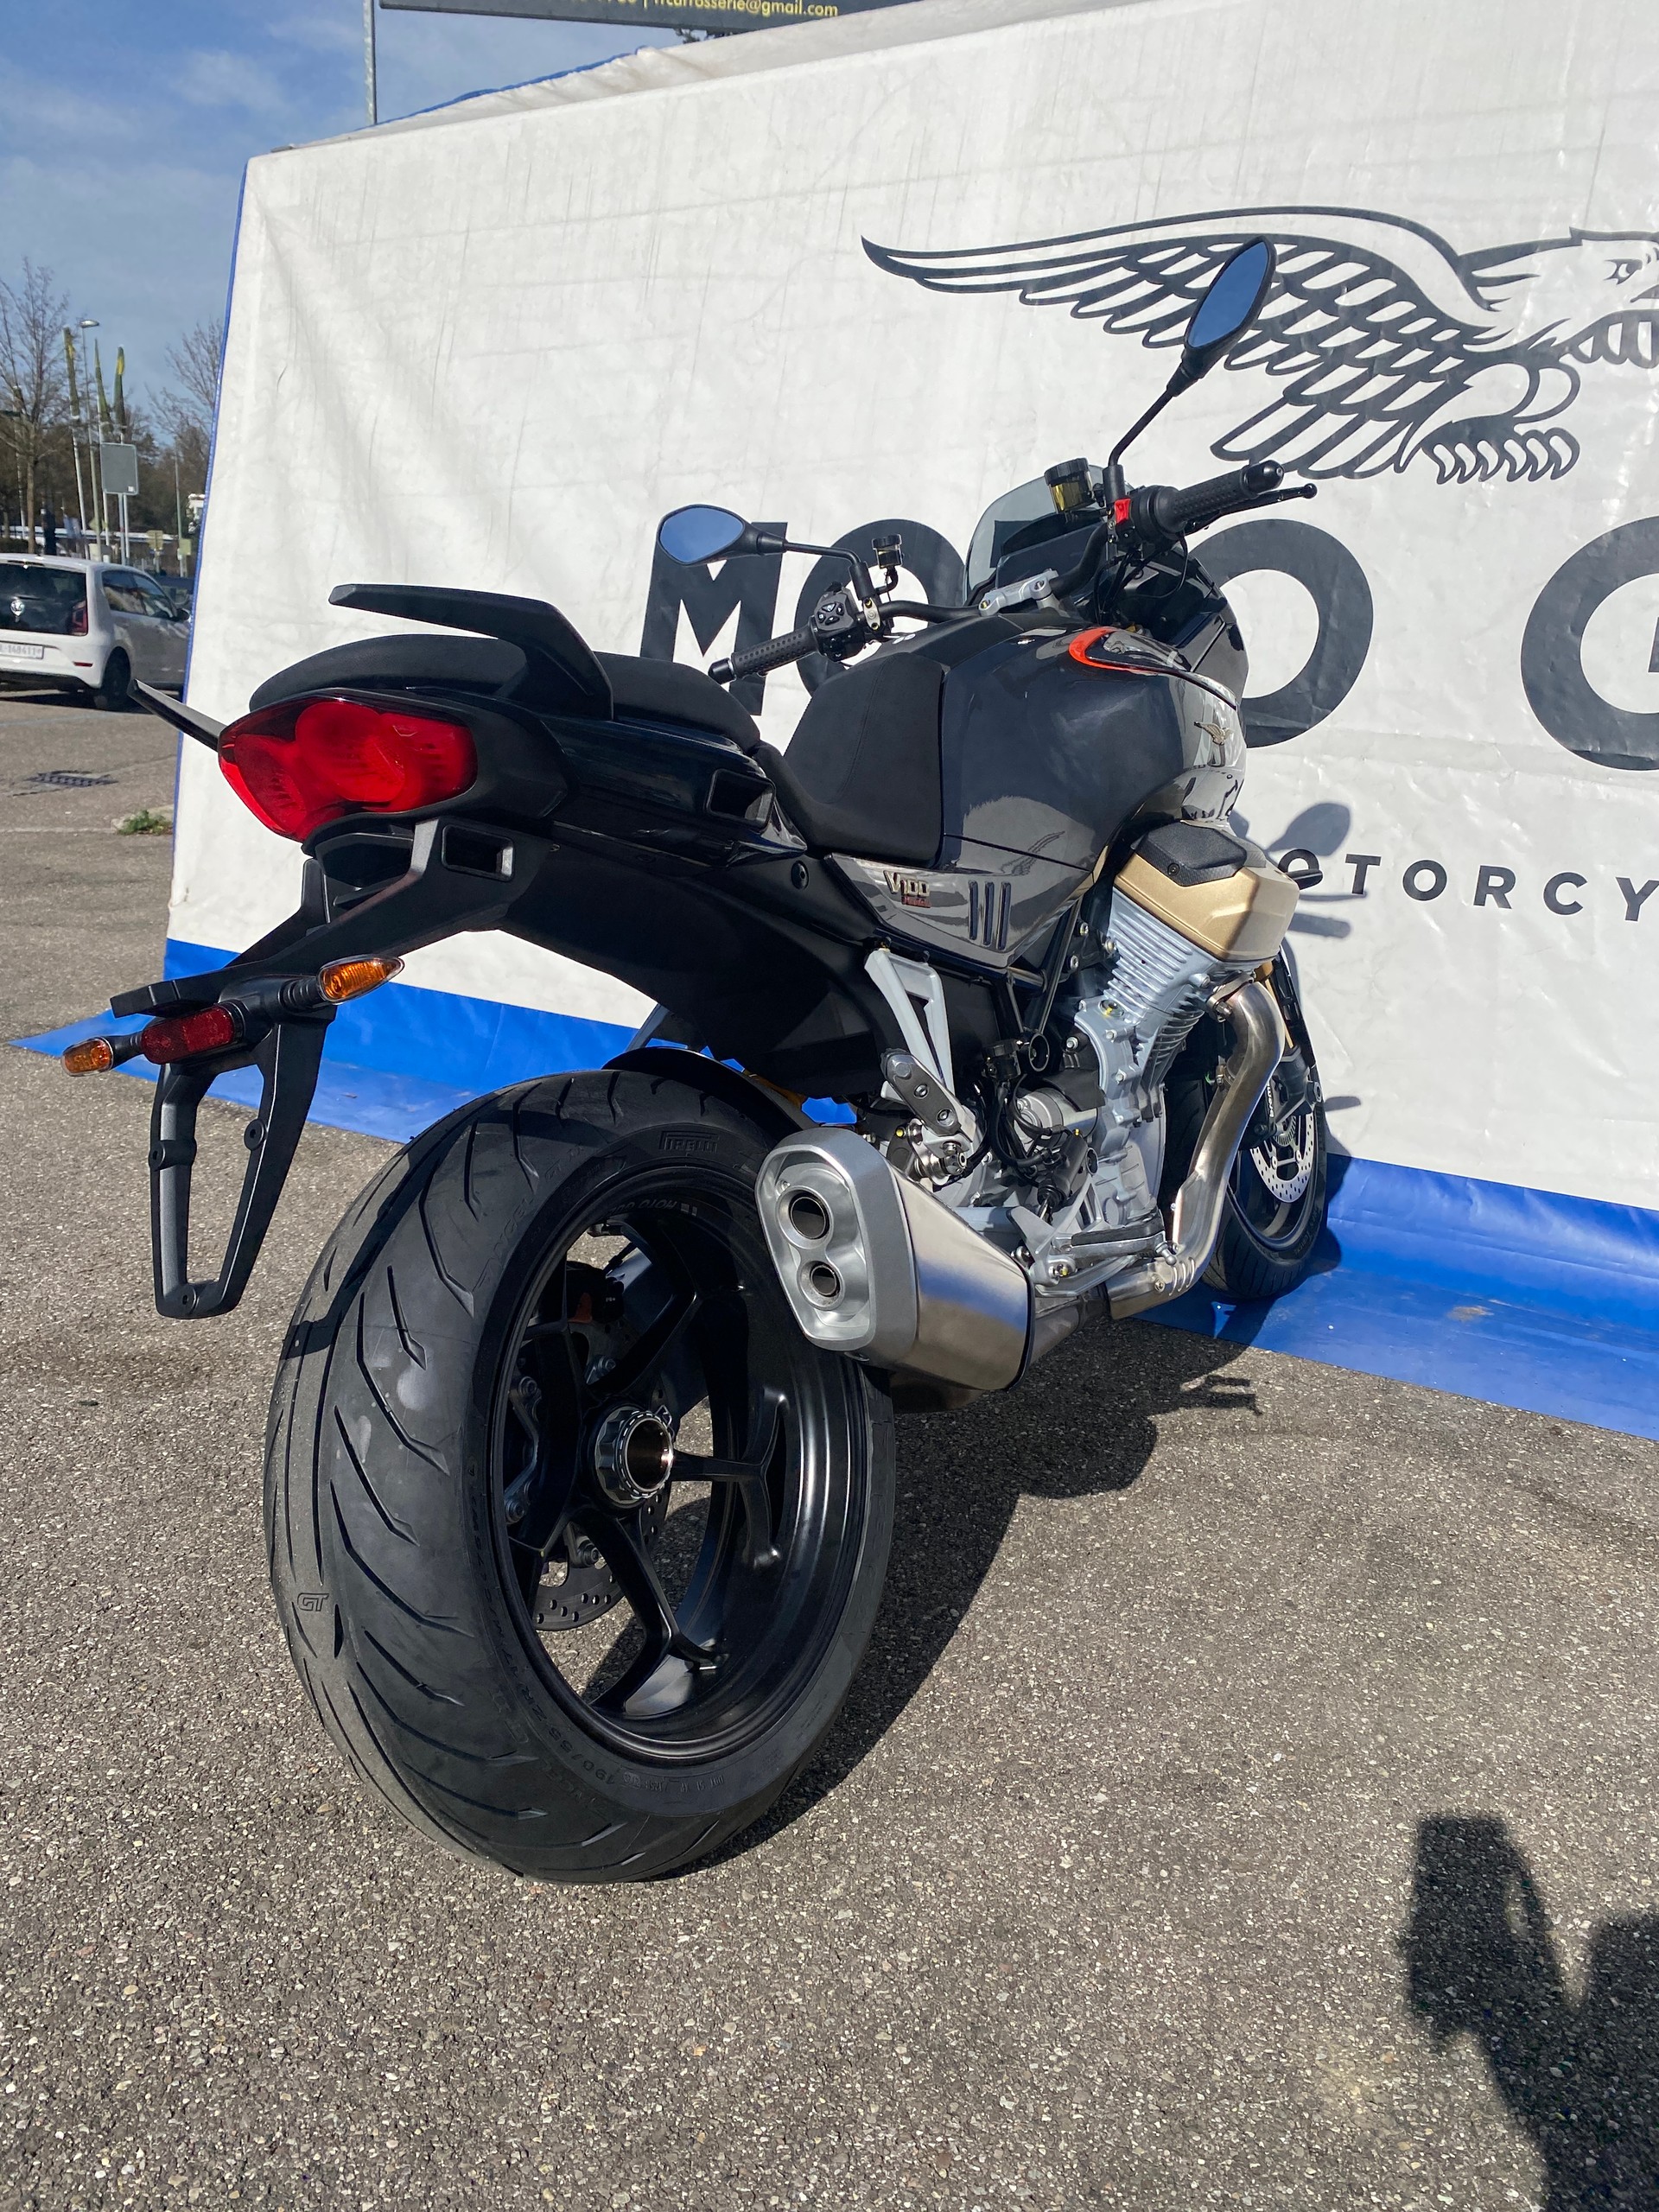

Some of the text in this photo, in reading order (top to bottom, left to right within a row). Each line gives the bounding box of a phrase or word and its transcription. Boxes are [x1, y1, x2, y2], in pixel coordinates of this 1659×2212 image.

[639, 518, 1375, 748] MOO
[883, 869, 931, 898] V100
[658, 1130, 719, 1154] PIRELLI
[296, 1592, 330, 1612] GT
